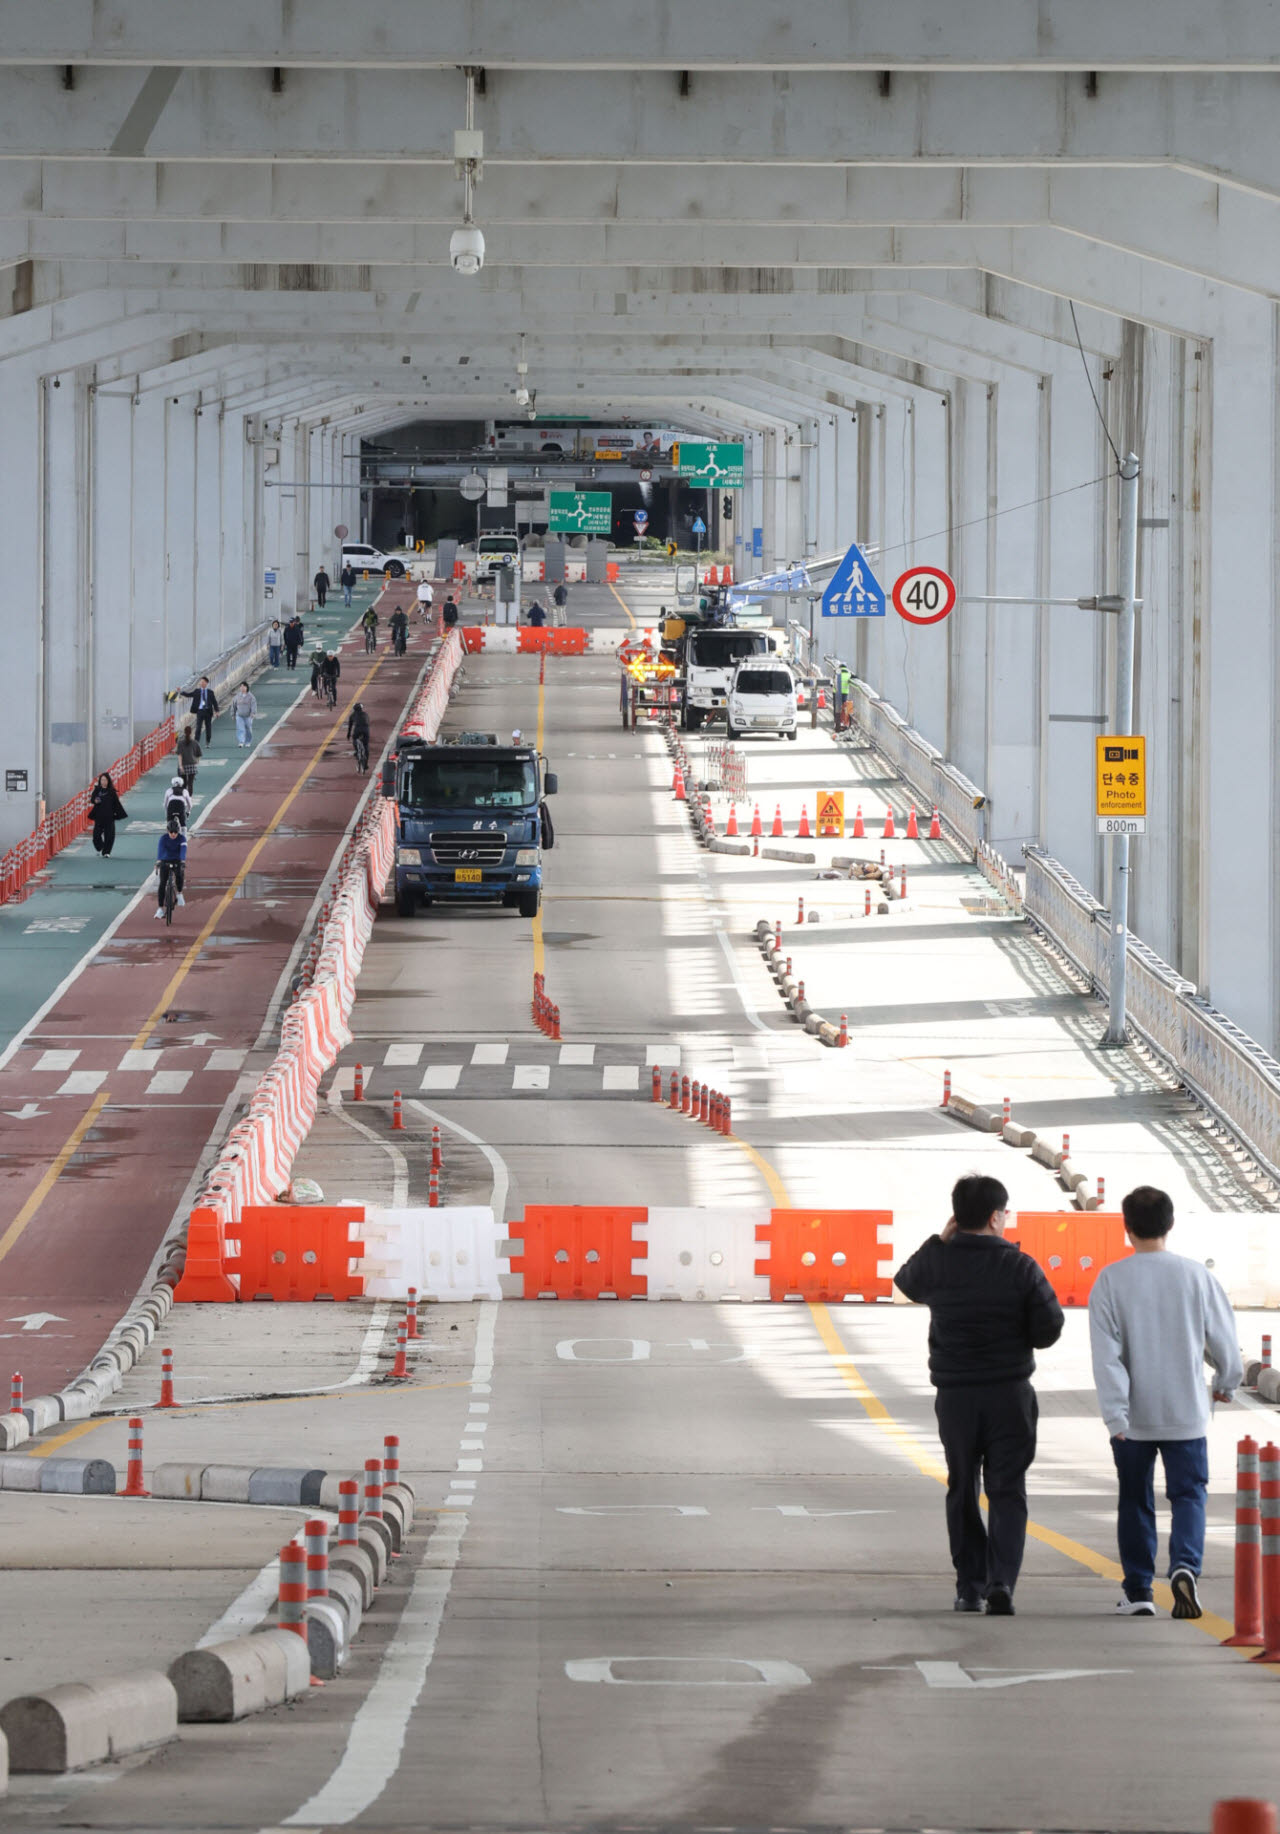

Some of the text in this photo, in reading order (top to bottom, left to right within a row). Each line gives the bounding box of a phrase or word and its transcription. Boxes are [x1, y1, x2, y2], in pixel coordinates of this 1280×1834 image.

[574, 493, 586, 501] 서초
[907, 580, 939, 611] 40
[829, 603, 879, 614] 횡단보도
[1102, 772, 1139, 786] 단속중
[1106, 790, 1136, 799] Photo
[1100, 801, 1142, 809] enforcement
[1106, 820, 1137, 832] 800m
